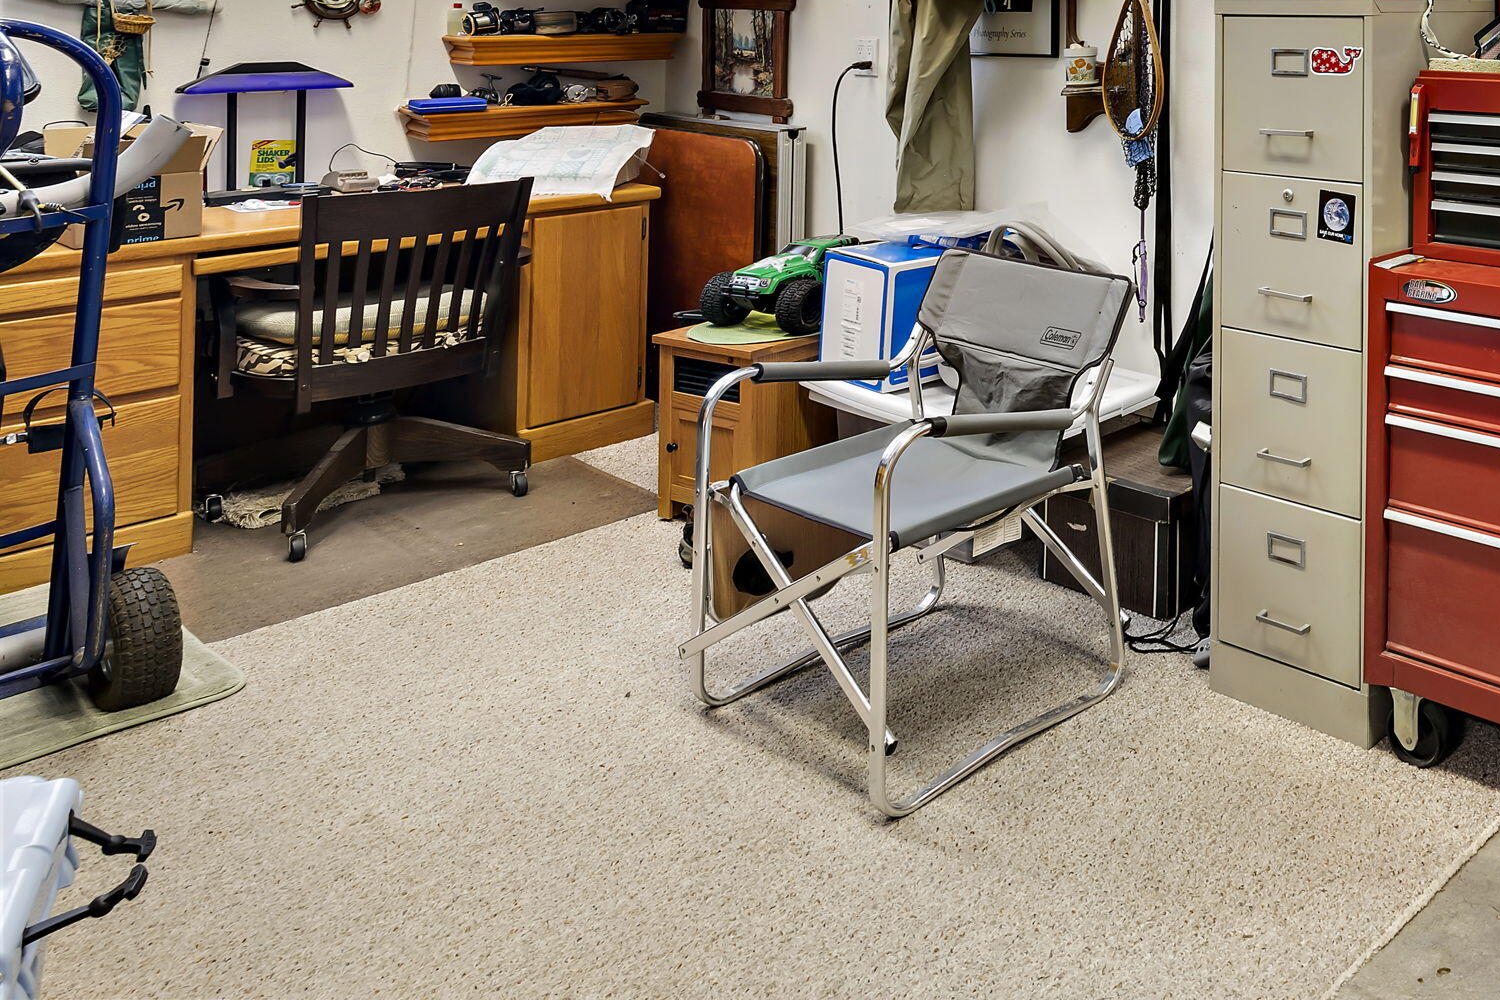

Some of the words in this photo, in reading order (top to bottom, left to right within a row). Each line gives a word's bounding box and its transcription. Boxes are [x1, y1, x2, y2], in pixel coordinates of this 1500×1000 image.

[973, 27, 1009, 41] Photography
[1010, 29, 1027, 39] Series
[1045, 329, 1071, 344] Coleman
